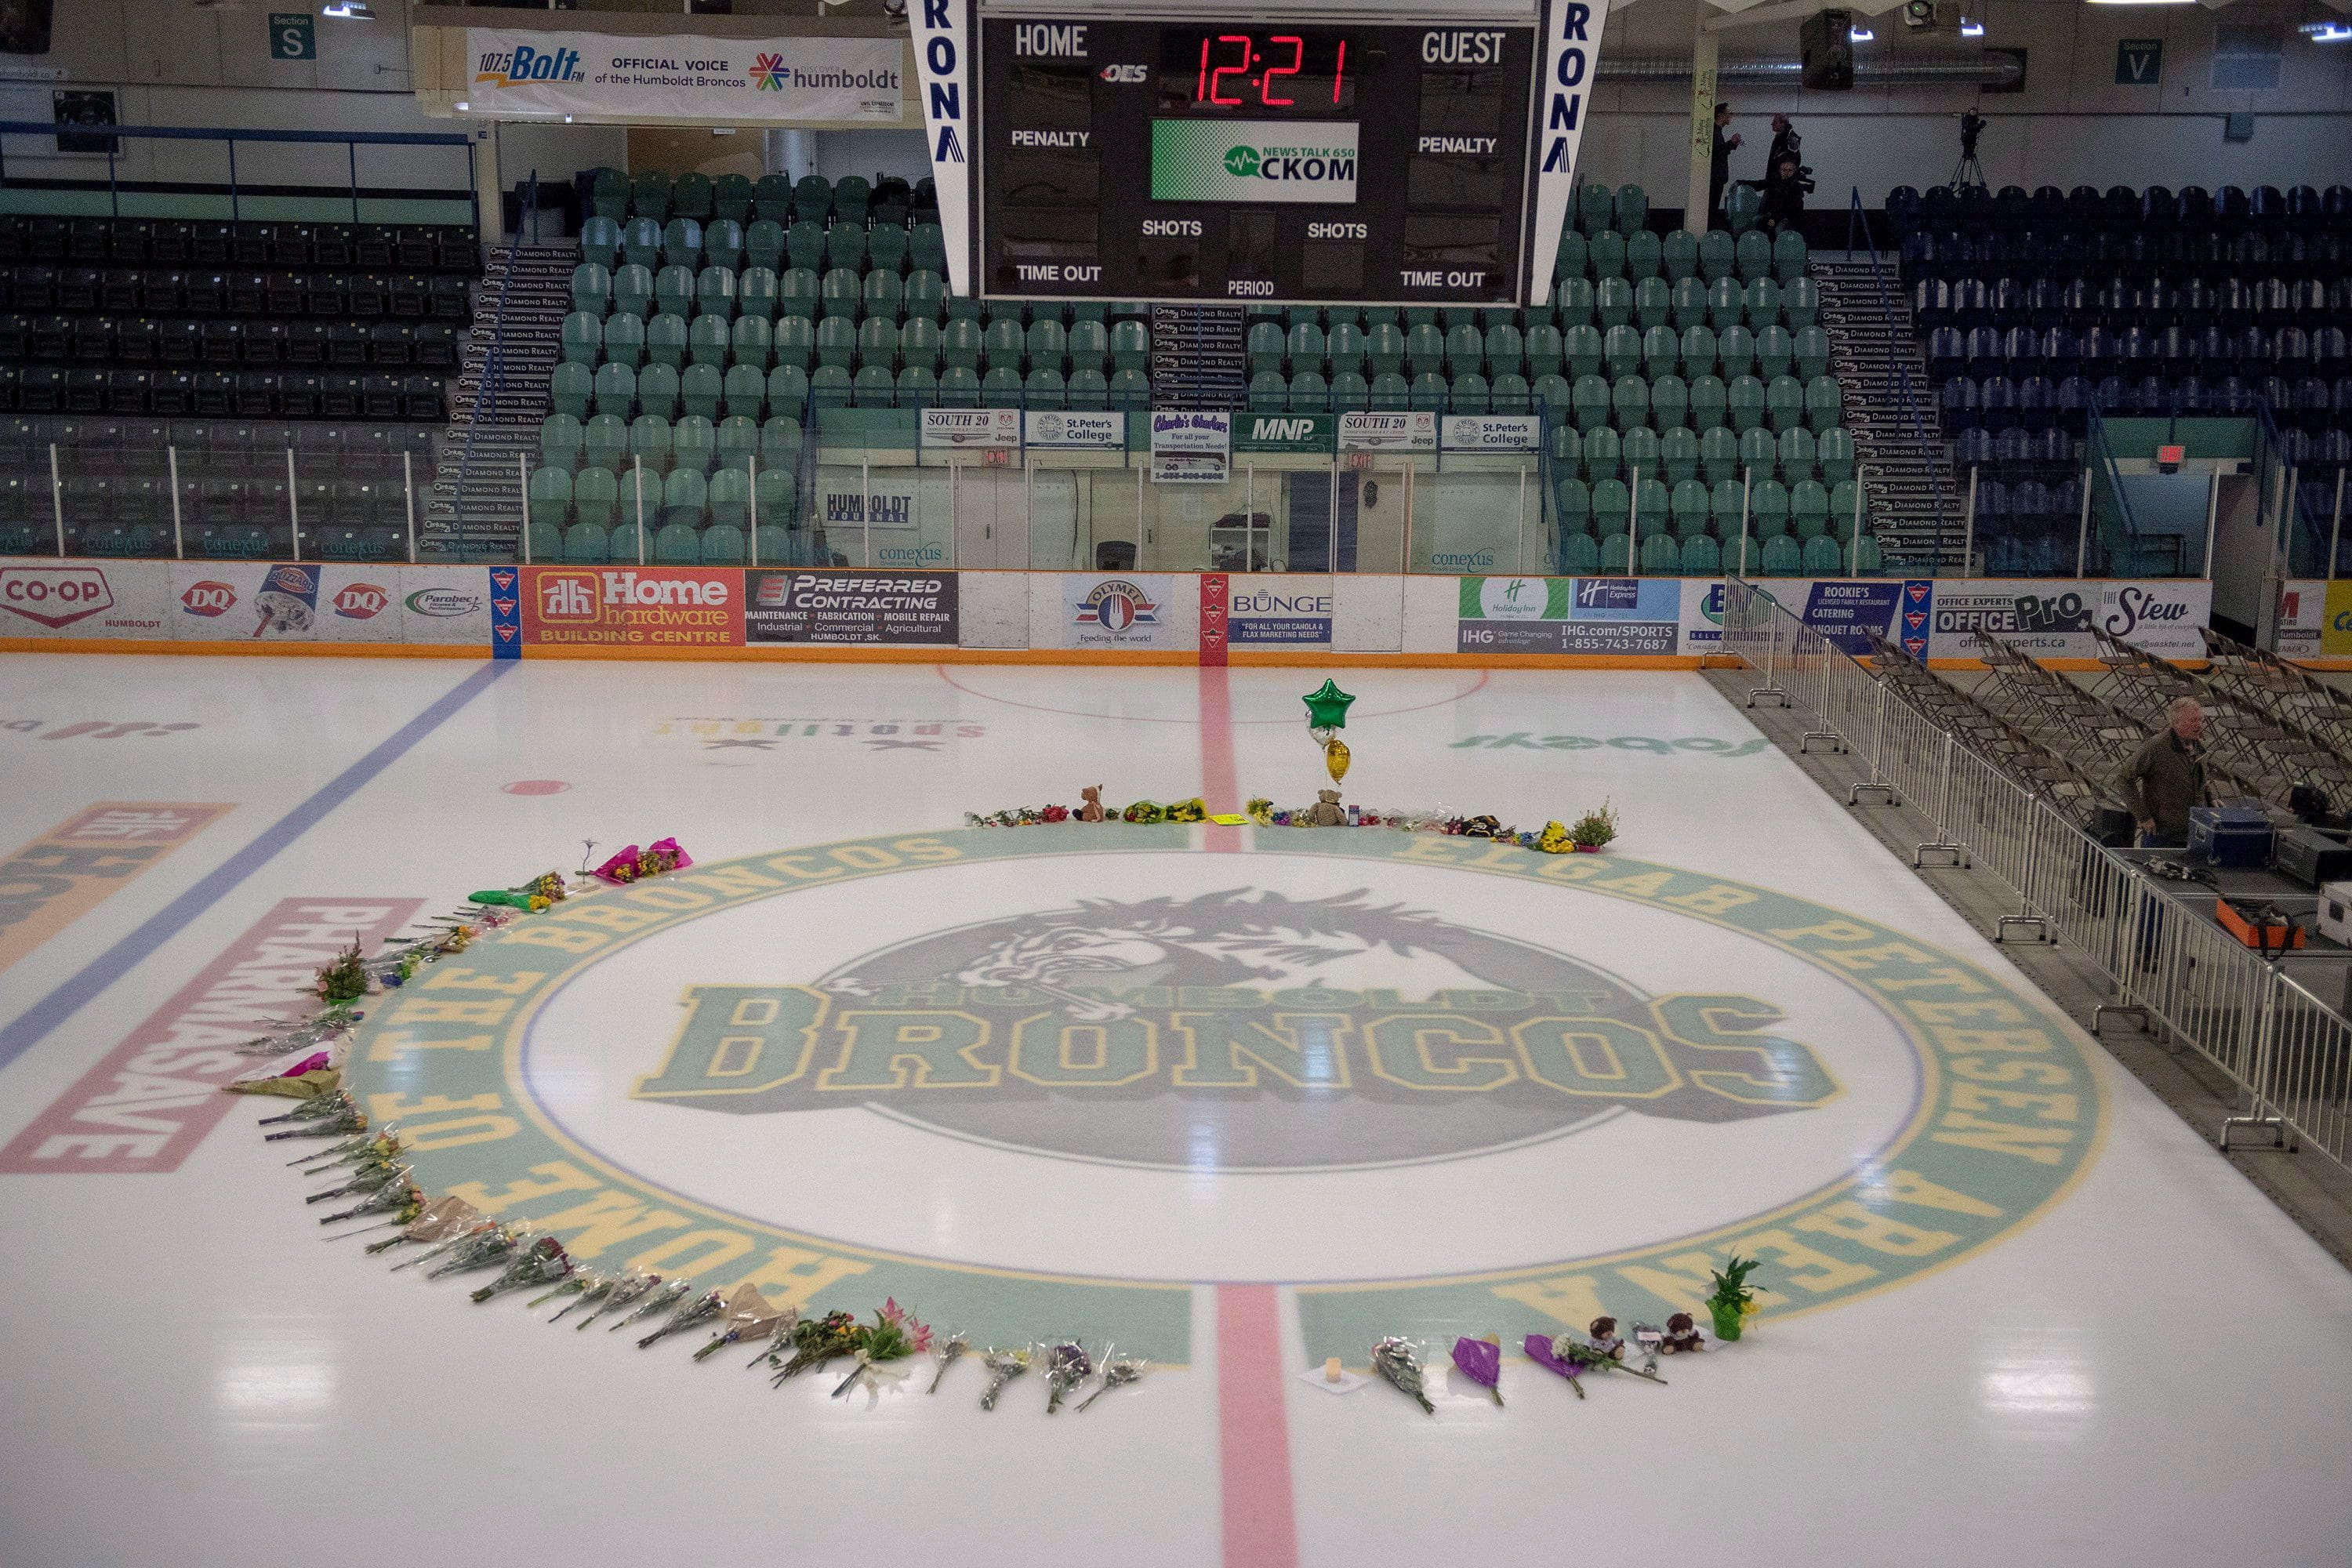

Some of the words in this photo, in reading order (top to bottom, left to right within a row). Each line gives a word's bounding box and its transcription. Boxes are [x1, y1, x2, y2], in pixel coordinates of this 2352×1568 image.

[283, 29, 303, 56] S
[1016, 24, 1087, 56] HOME
[1422, 31, 1505, 64] GUEST
[479, 53, 512, 71] 107.5
[510, 46, 580, 80] Bolt
[612, 58, 679, 70] OFFICIAL
[685, 60, 728, 71] VOICE
[1197, 35, 1345, 105] 12:21
[2129, 54, 2149, 79] V
[595, 74, 608, 83] of
[611, 75, 630, 84] the
[634, 75, 693, 86] Humboldt
[697, 78, 745, 87] Broncos
[794, 69, 898, 89] humboldt
[1105, 64, 1148, 82] OES
[1542, 2, 1590, 172] RONA
[1012, 131, 1090, 147] PENALTY
[1419, 137, 1497, 153] PENALTY
[1263, 147, 1298, 156] NEWS
[1334, 148, 1355, 157] 650
[1261, 158, 1354, 180] CKOM
[1142, 220, 1202, 236] SHOTS
[1308, 223, 1367, 238] SHOTS
[1016, 265, 1058, 281] TIME
[1063, 266, 1102, 281] OUT
[1400, 270, 1442, 288] TIME
[1448, 272, 1485, 288] OUT
[1229, 281, 1273, 296] PERIOD
[927, 415, 971, 426] SOUTH
[975, 416, 989, 426] 20
[1345, 417, 1389, 429] SOUTH
[1392, 419, 1406, 429] 20
[995, 434, 1017, 443] Jeep
[1068, 430, 1112, 441] College
[1252, 419, 1315, 441] MNP
[1411, 436, 1433, 445] Jeep
[1483, 434, 1528, 445] College
[988, 450, 1007, 463] EXIT
[1351, 453, 1370, 468] EXIT
[879, 541, 942, 567] conexus
[1432, 548, 1494, 572] conexus
[6, 580, 100, 601] CO-OP
[602, 572, 728, 605] Home
[793, 575, 942, 593] PREFERRED
[1092, 583, 1138, 602] OLYMEL
[1824, 587, 1869, 598] ROOKIE'S
[191, 589, 230, 608] DQ
[343, 591, 380, 612] DQ
[425, 594, 470, 603] Parobec
[796, 593, 937, 609] CONTRACTING
[1234, 589, 1331, 612] BUNGE
[1937, 597, 1971, 606] OFFICE
[1973, 597, 2013, 607] EXPERTS
[2103, 591, 2117, 604] THE
[604, 605, 728, 626] hardware
[746, 612, 808, 620] MAINTENANCE
[818, 612, 874, 621] FABRICATION
[920, 613, 949, 622] REPAIR
[1493, 604, 1522, 614] Holiday
[1813, 608, 1854, 618] CATERING
[2014, 592, 2082, 631] Pro
[2106, 586, 2188, 637] Stew
[757, 622, 802, 631] Industrial
[815, 622, 873, 632] Commercial
[885, 624, 941, 634] Agricultural
[1940, 612, 2015, 630] OFFICE
[540, 630, 644, 642] BUILDING
[652, 631, 730, 642] CENTRE
[1081, 634, 1111, 643] Feeding
[1463, 630, 1494, 643] IHG
[1562, 626, 1673, 637] IHG.com/SPORTS
[1562, 639, 1667, 650] 1-855-743-7687
[1447, 733, 1770, 758] Sobeys
[1392, 835, 1762, 917] ELGAR
[506, 837, 963, 954] BRONCOS
[864, 985, 1617, 1012] HUMBOLDT
[366, 967, 544, 1065] THE
[630, 985, 1849, 1108] BRONCOS
[1766, 919, 2081, 1166] PETERSEN
[367, 1092, 523, 1152] OF
[443, 1160, 880, 1316] HOME
[1491, 1170, 2006, 1338] ARENA
